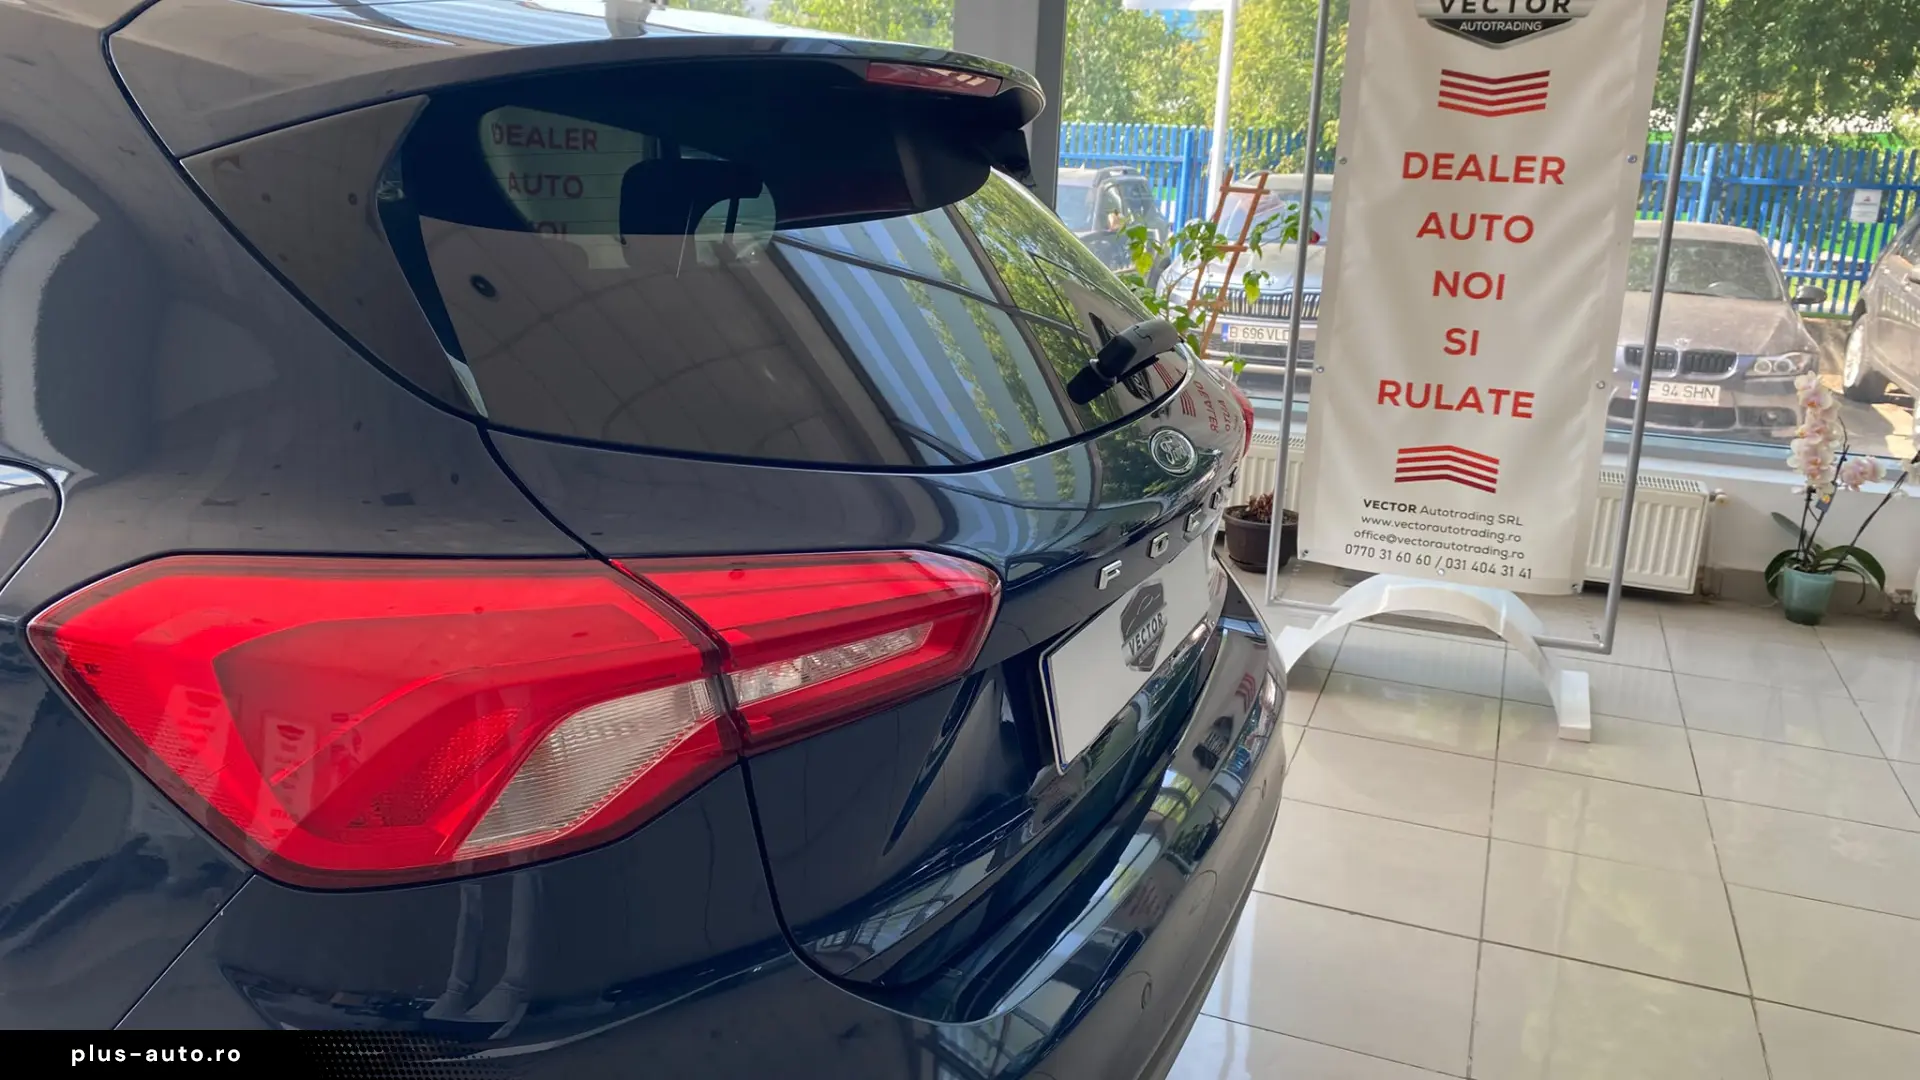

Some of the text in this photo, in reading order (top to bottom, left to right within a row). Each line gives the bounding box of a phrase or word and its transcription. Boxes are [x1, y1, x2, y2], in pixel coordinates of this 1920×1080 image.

[1459, 20, 1543, 31] AUTOTRADING
[1402, 151, 1566, 185] DEALER
[508, 171, 584, 198] AUTO
[1416, 211, 1535, 243] AUTO
[1432, 270, 1506, 301] NOI
[1242, 326, 1265, 339] 696
[1443, 327, 1480, 356] SI
[1377, 379, 1535, 419] RULATE
[1661, 383, 1678, 397] 94
[1683, 385, 1716, 399] SHN
[1363, 498, 1524, 527] VECTOR Autotrading SRL
[1361, 515, 1522, 543] www.vectorautotrading.ro
[1353, 529, 1526, 560] office@vectorautotrading.ro
[1345, 543, 1532, 580] 0770 31 60 60 / 031 404 31 41
[1128, 611, 1163, 657] VECTOR
